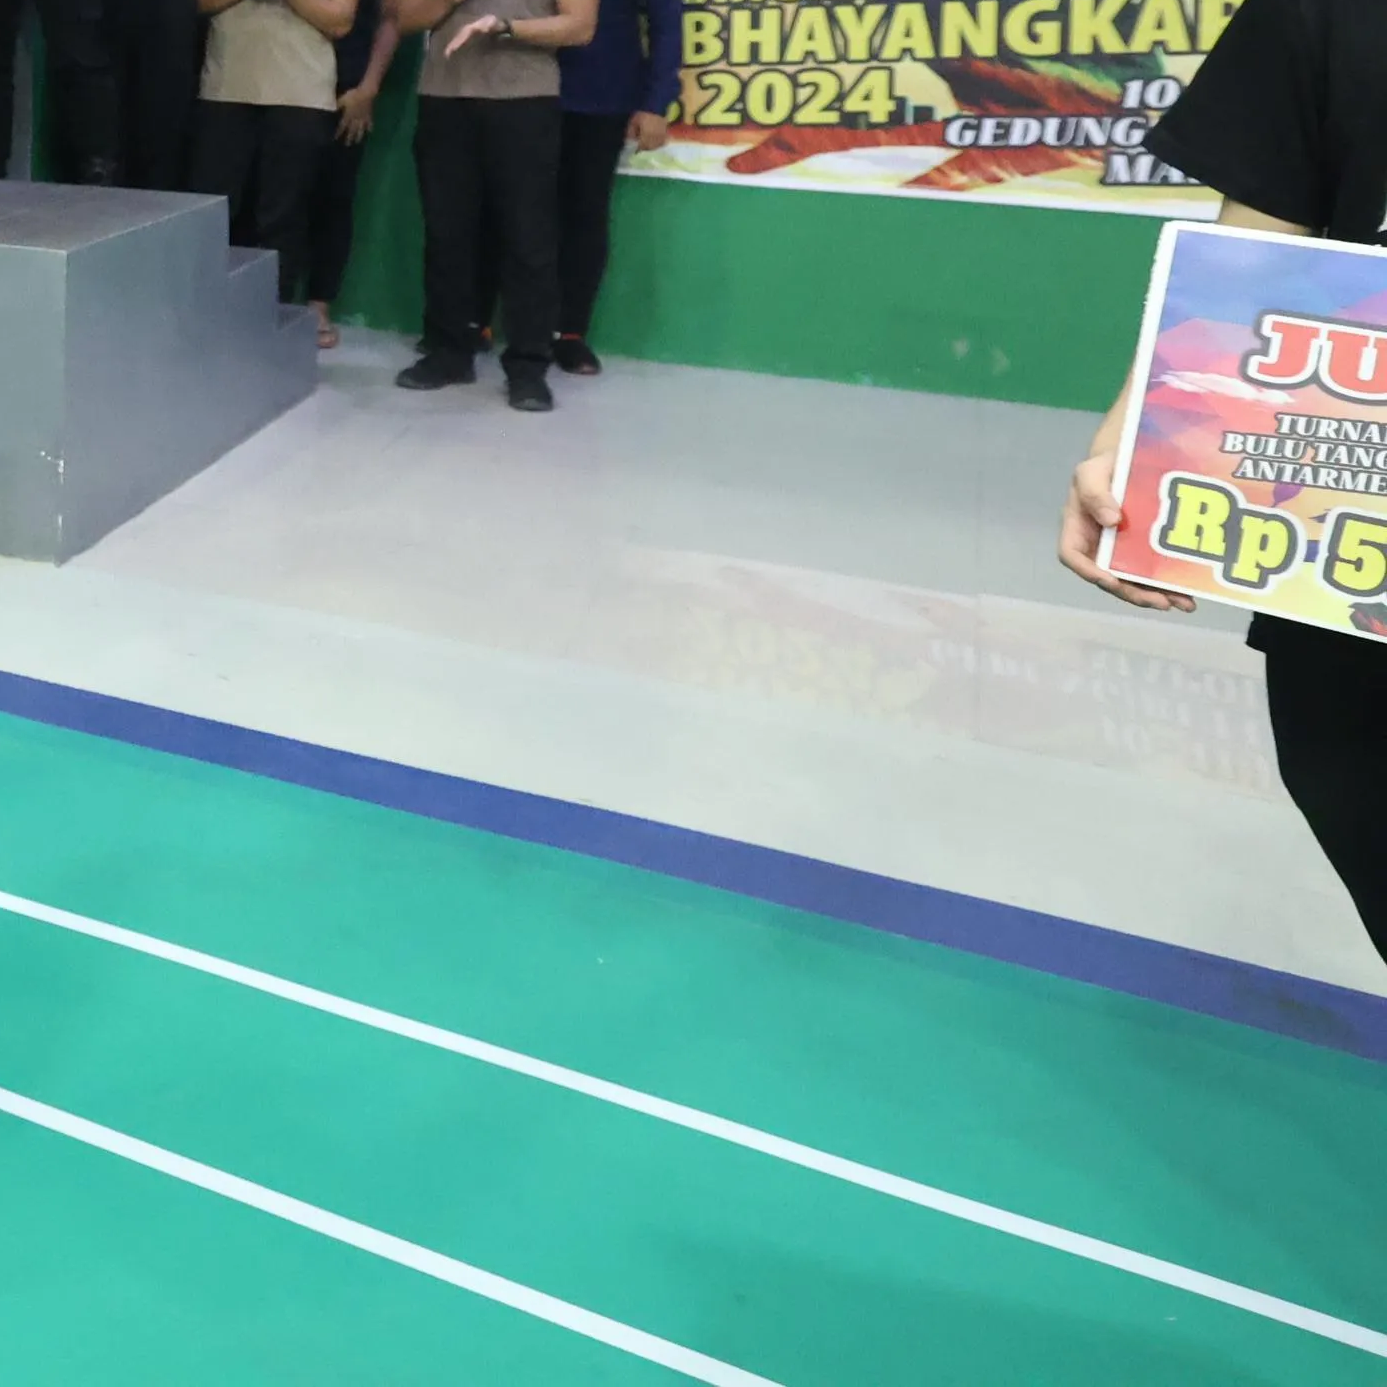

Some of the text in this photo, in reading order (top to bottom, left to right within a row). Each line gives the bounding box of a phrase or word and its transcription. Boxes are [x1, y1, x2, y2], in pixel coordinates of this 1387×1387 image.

[696, 67, 897, 127] 2024
[1121, 77, 1182, 111] 10
[943, 115, 1153, 149] GEDUNG
[1277, 414, 1387, 445] TURNA
[1222, 433, 1305, 463] BULU
[1163, 482, 1295, 586] Rp
